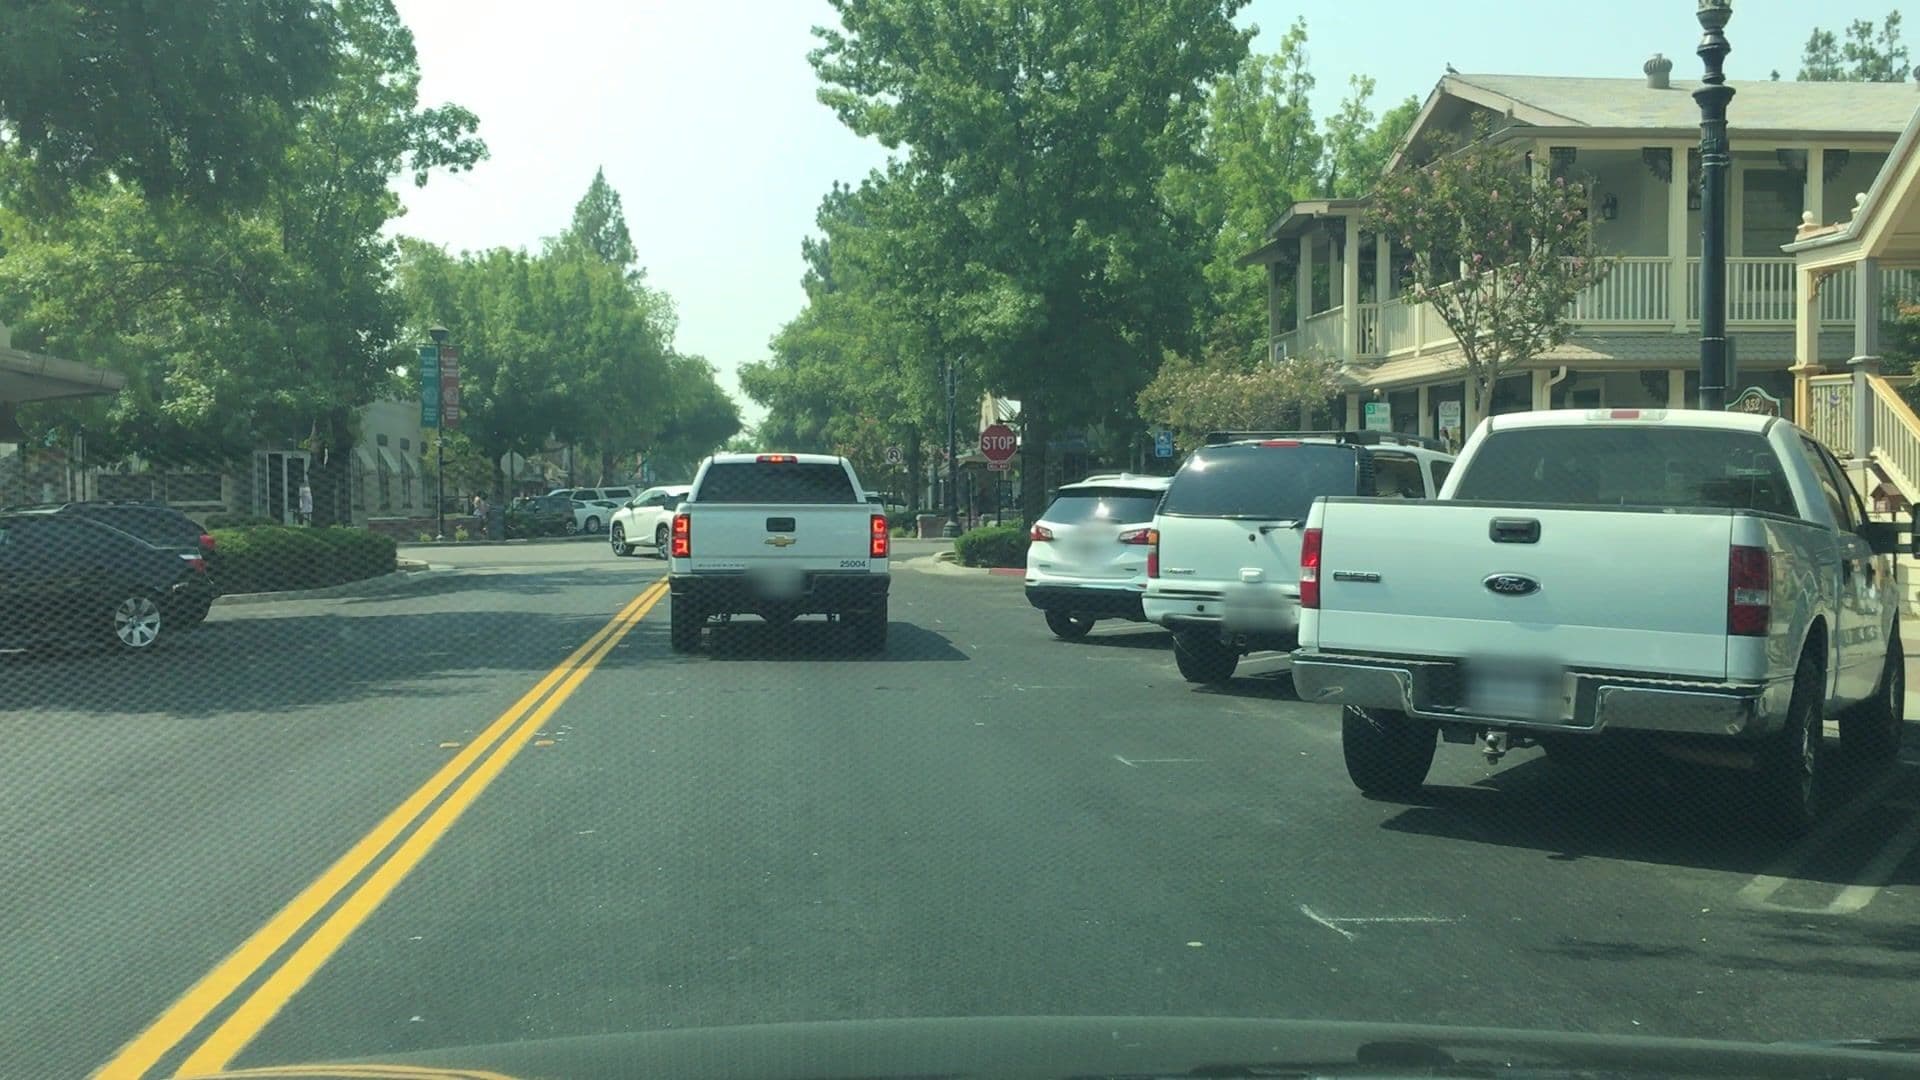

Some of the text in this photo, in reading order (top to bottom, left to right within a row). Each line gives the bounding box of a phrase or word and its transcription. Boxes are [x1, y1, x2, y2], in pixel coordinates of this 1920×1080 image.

[982, 435, 1015, 450] STOP
[839, 559, 867, 568] 25004
[1494, 577, 1526, 591] Ford
